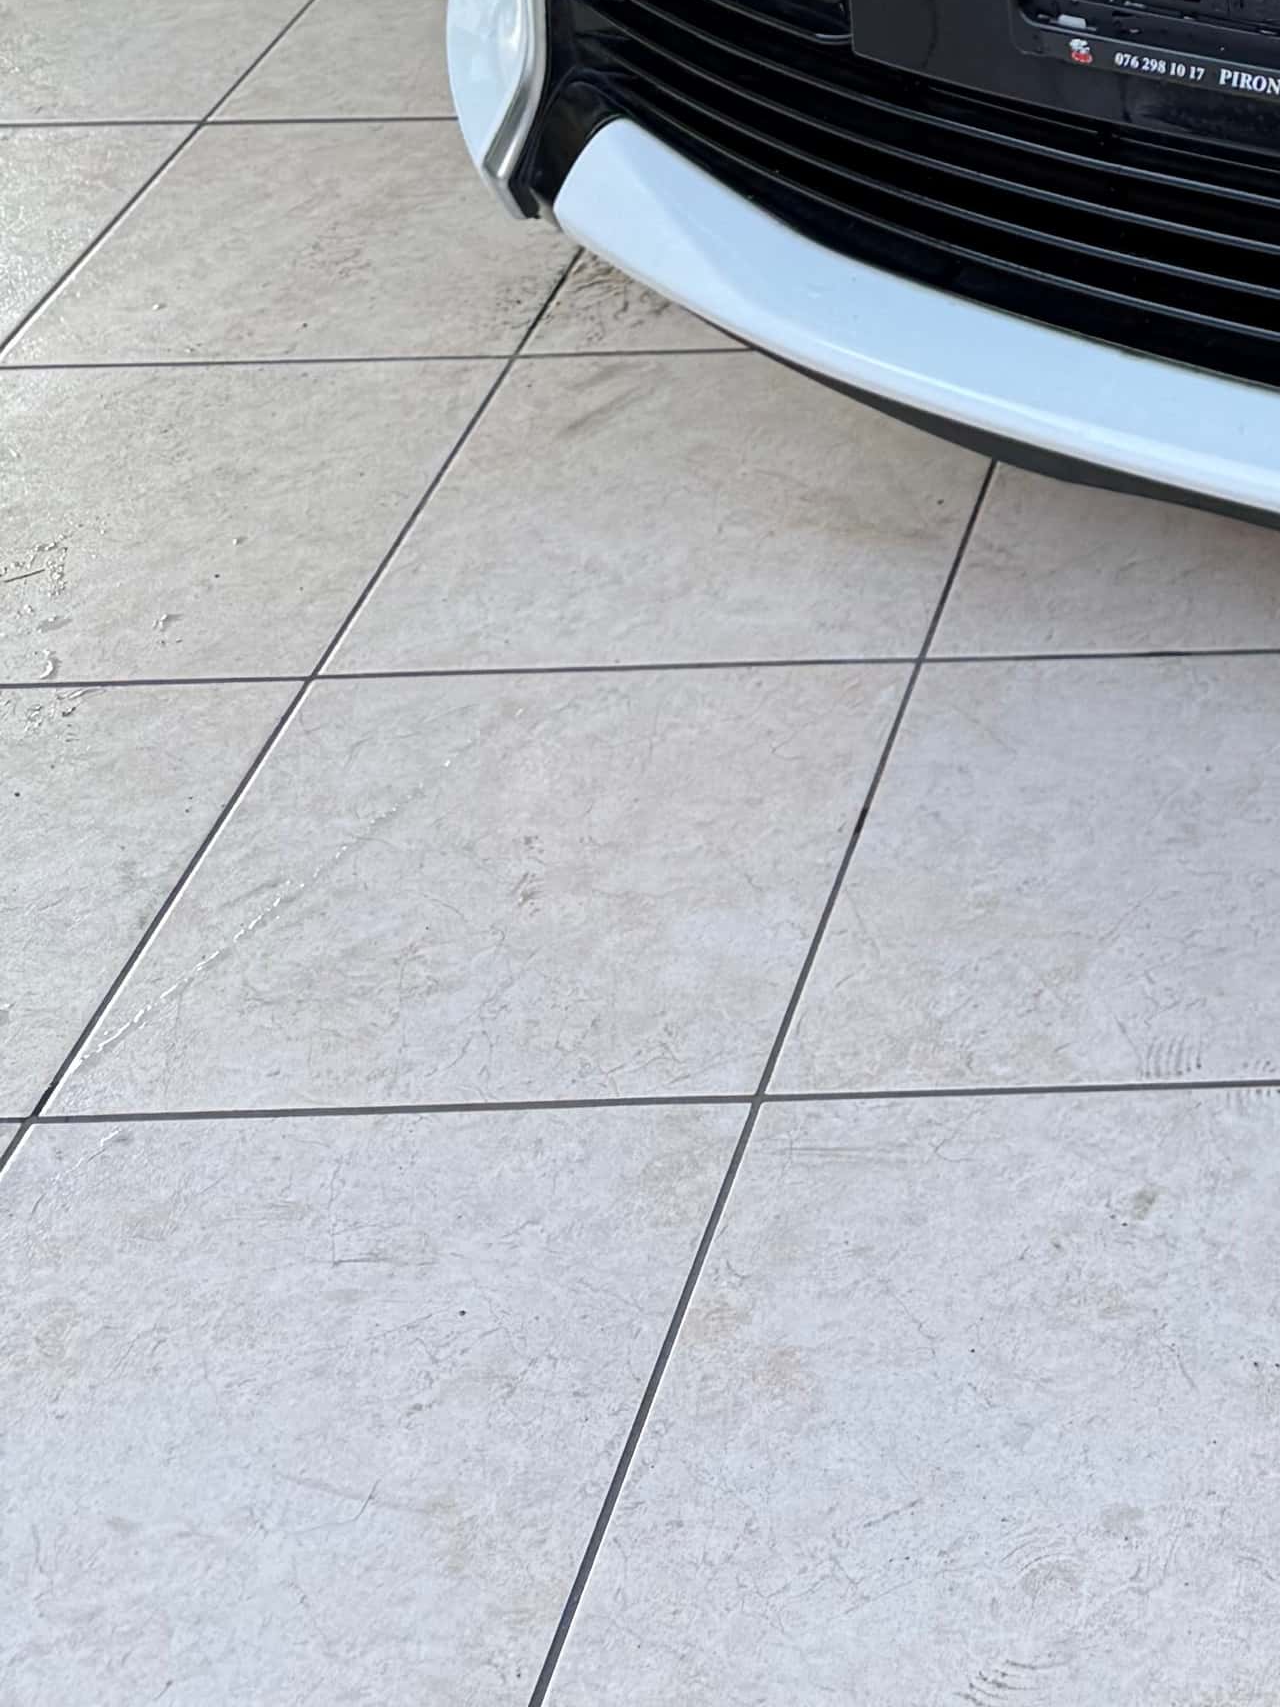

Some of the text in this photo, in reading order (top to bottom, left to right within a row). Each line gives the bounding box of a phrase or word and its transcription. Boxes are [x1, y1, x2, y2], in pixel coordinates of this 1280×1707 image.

[1114, 52, 1139, 68] 076
[1142, 57, 1166, 75] 298
[1170, 62, 1186, 77] 10
[1190, 66, 1206, 81] 17
